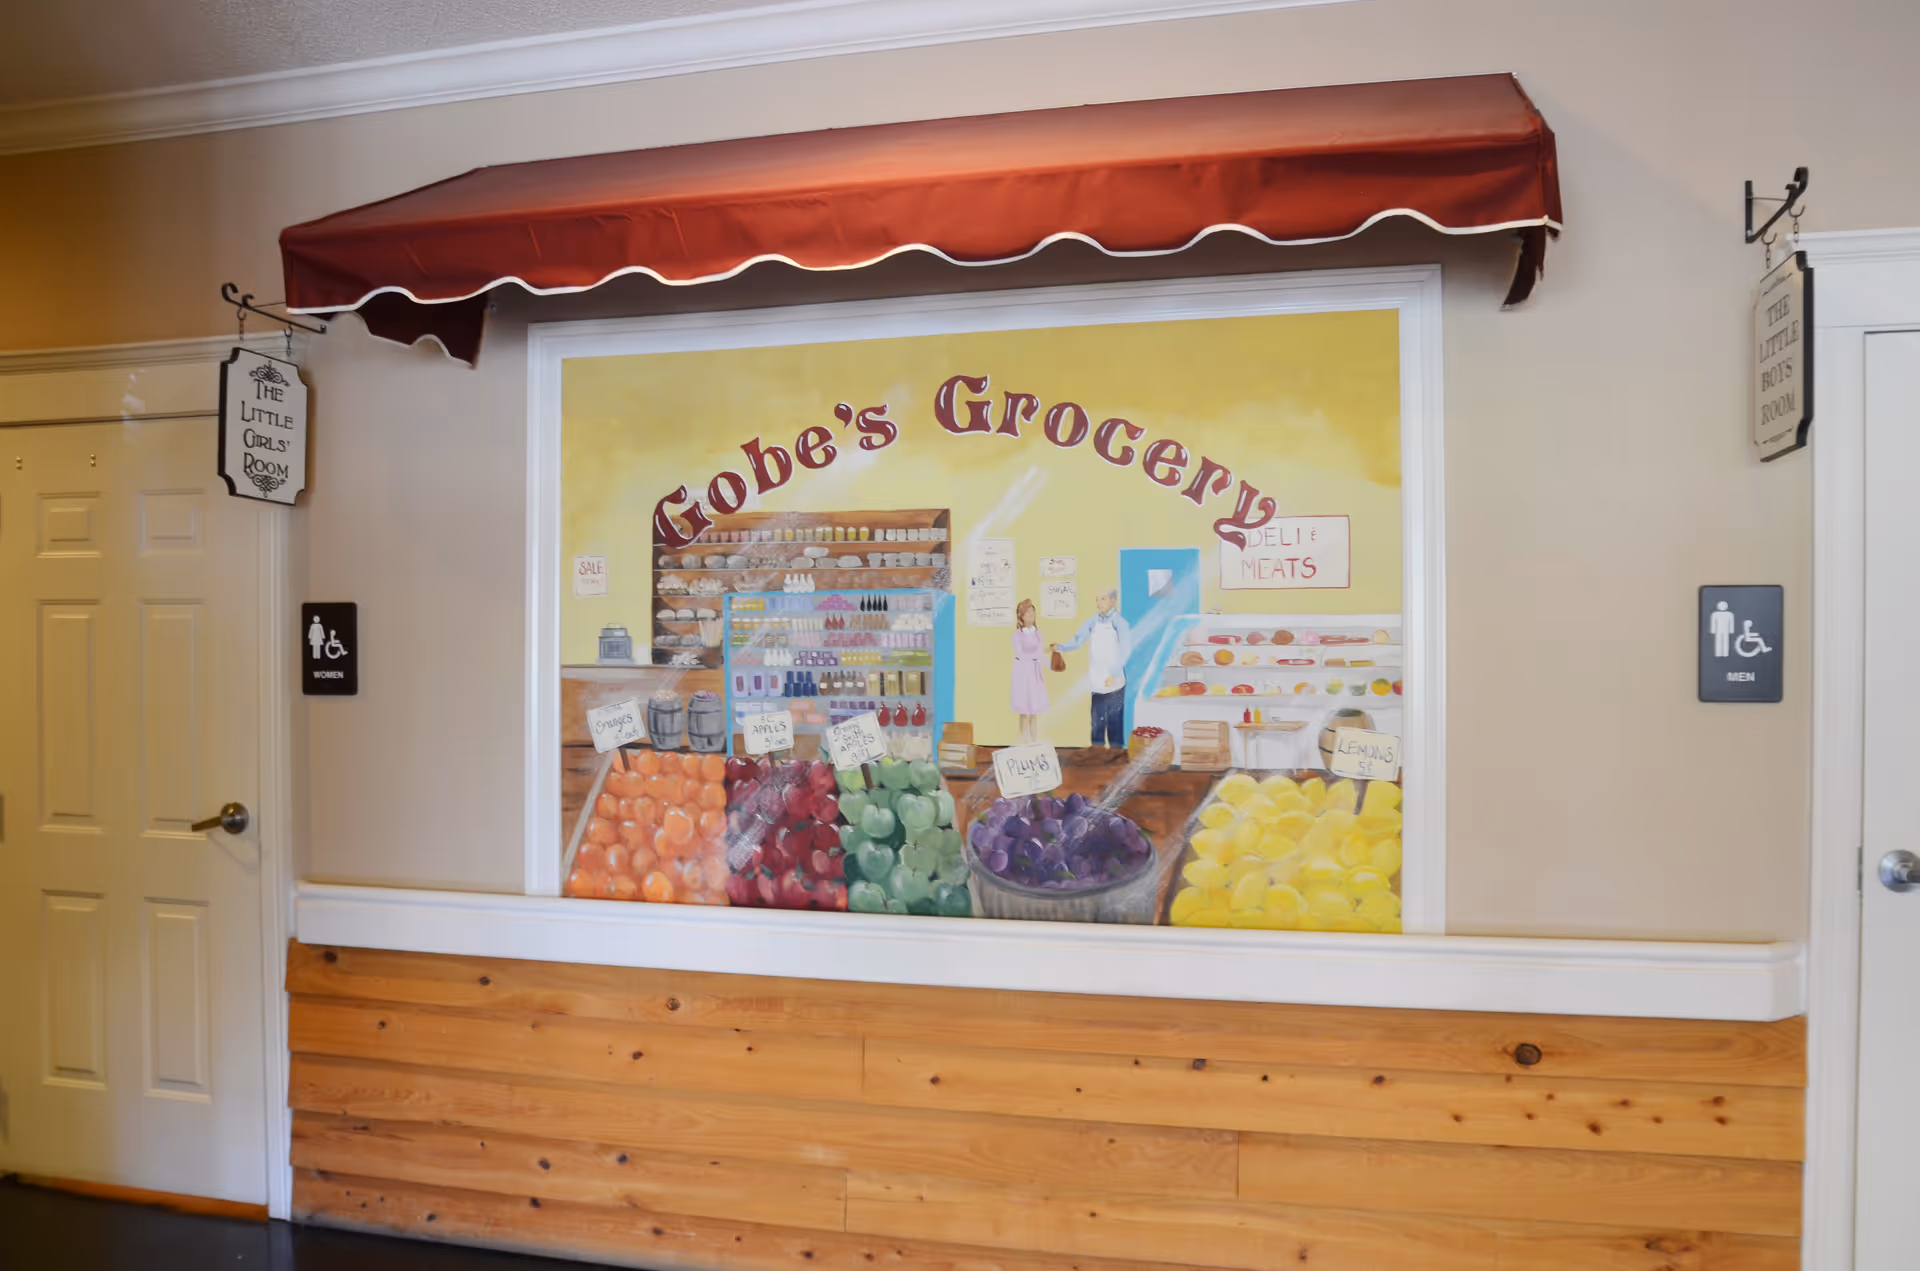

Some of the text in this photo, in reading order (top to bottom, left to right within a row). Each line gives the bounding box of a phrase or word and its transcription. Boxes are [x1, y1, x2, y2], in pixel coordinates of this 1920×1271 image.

[1766, 294, 1790, 327] THE
[1760, 320, 1799, 363] LITTLE
[254, 379, 283, 402] THE
[241, 400, 293, 429] LITTLE
[1761, 391, 1796, 426] ROOM
[243, 452, 288, 479] ROOM
[653, 373, 1279, 552] Gobe's Grocery
[1247, 527, 1300, 547] DELI
[579, 561, 604, 575] SALE
[1241, 557, 1317, 579] MEATS
[313, 671, 344, 679] WOMEN
[1727, 672, 1755, 682] MEN
[1338, 738, 1394, 763] LEMONS
[1006, 753, 1050, 777] PLUMS
